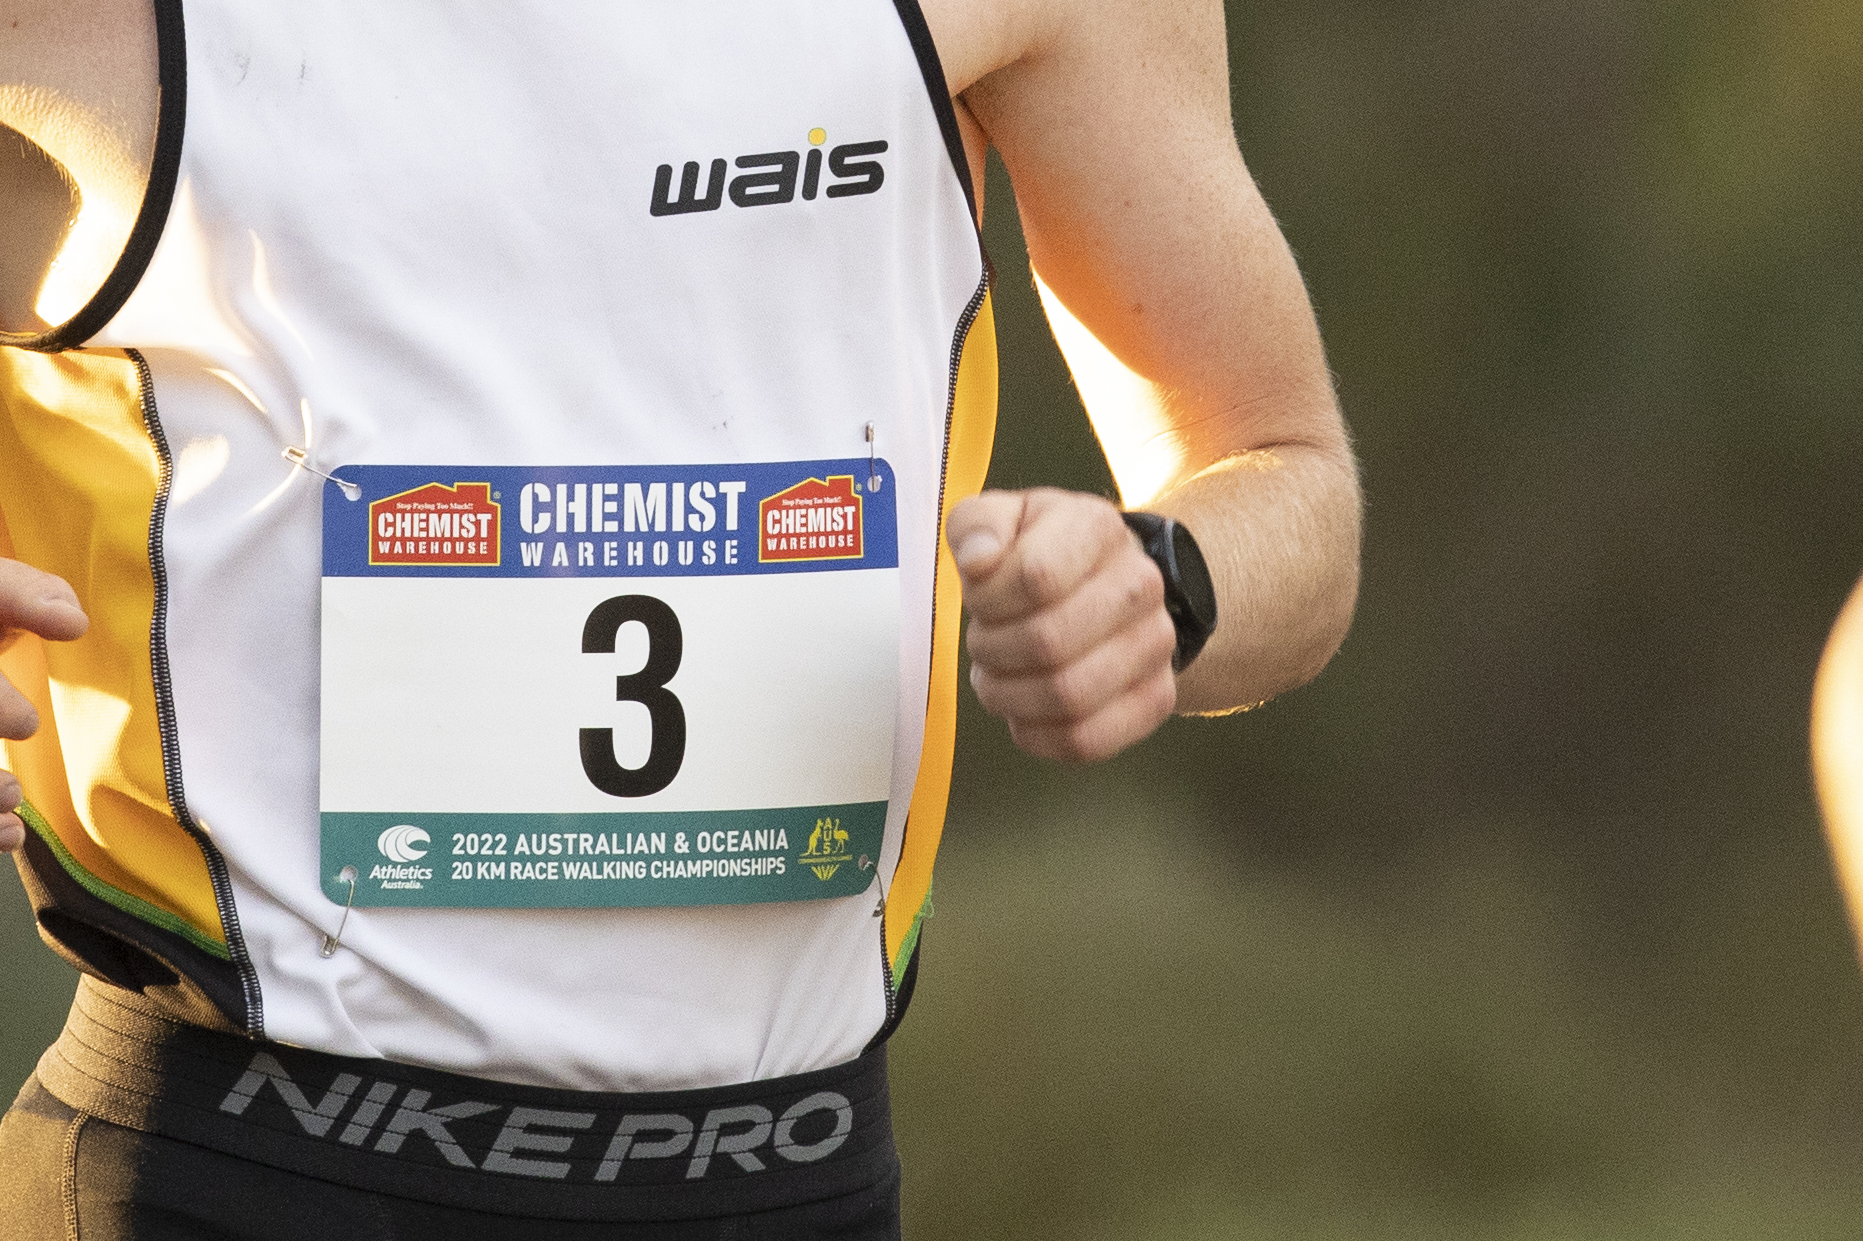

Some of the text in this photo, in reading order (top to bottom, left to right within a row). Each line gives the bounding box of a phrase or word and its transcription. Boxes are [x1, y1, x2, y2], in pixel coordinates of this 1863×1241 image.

[649, 126, 889, 217] wais
[520, 481, 747, 534] CHEMIST
[766, 505, 856, 535] CHEMIST
[378, 512, 492, 538] CHEMIST
[378, 541, 488, 554] WAREHOUSE
[520, 540, 738, 567] WAREHOUSE
[766, 534, 854, 551] WAREHOUSE
[579, 594, 687, 798] 3
[451, 828, 789, 855] 2022 AUSTRALIAN & OCEANIA
[369, 864, 433, 880] Athletics
[451, 861, 473, 880] 20
[476, 861, 505, 880] KM
[509, 861, 559, 880] RACE
[562, 860, 647, 880] WALKING
[650, 857, 786, 879] CHAMPIONSHIPS
[219, 1052, 853, 1181] NIKE PRO
